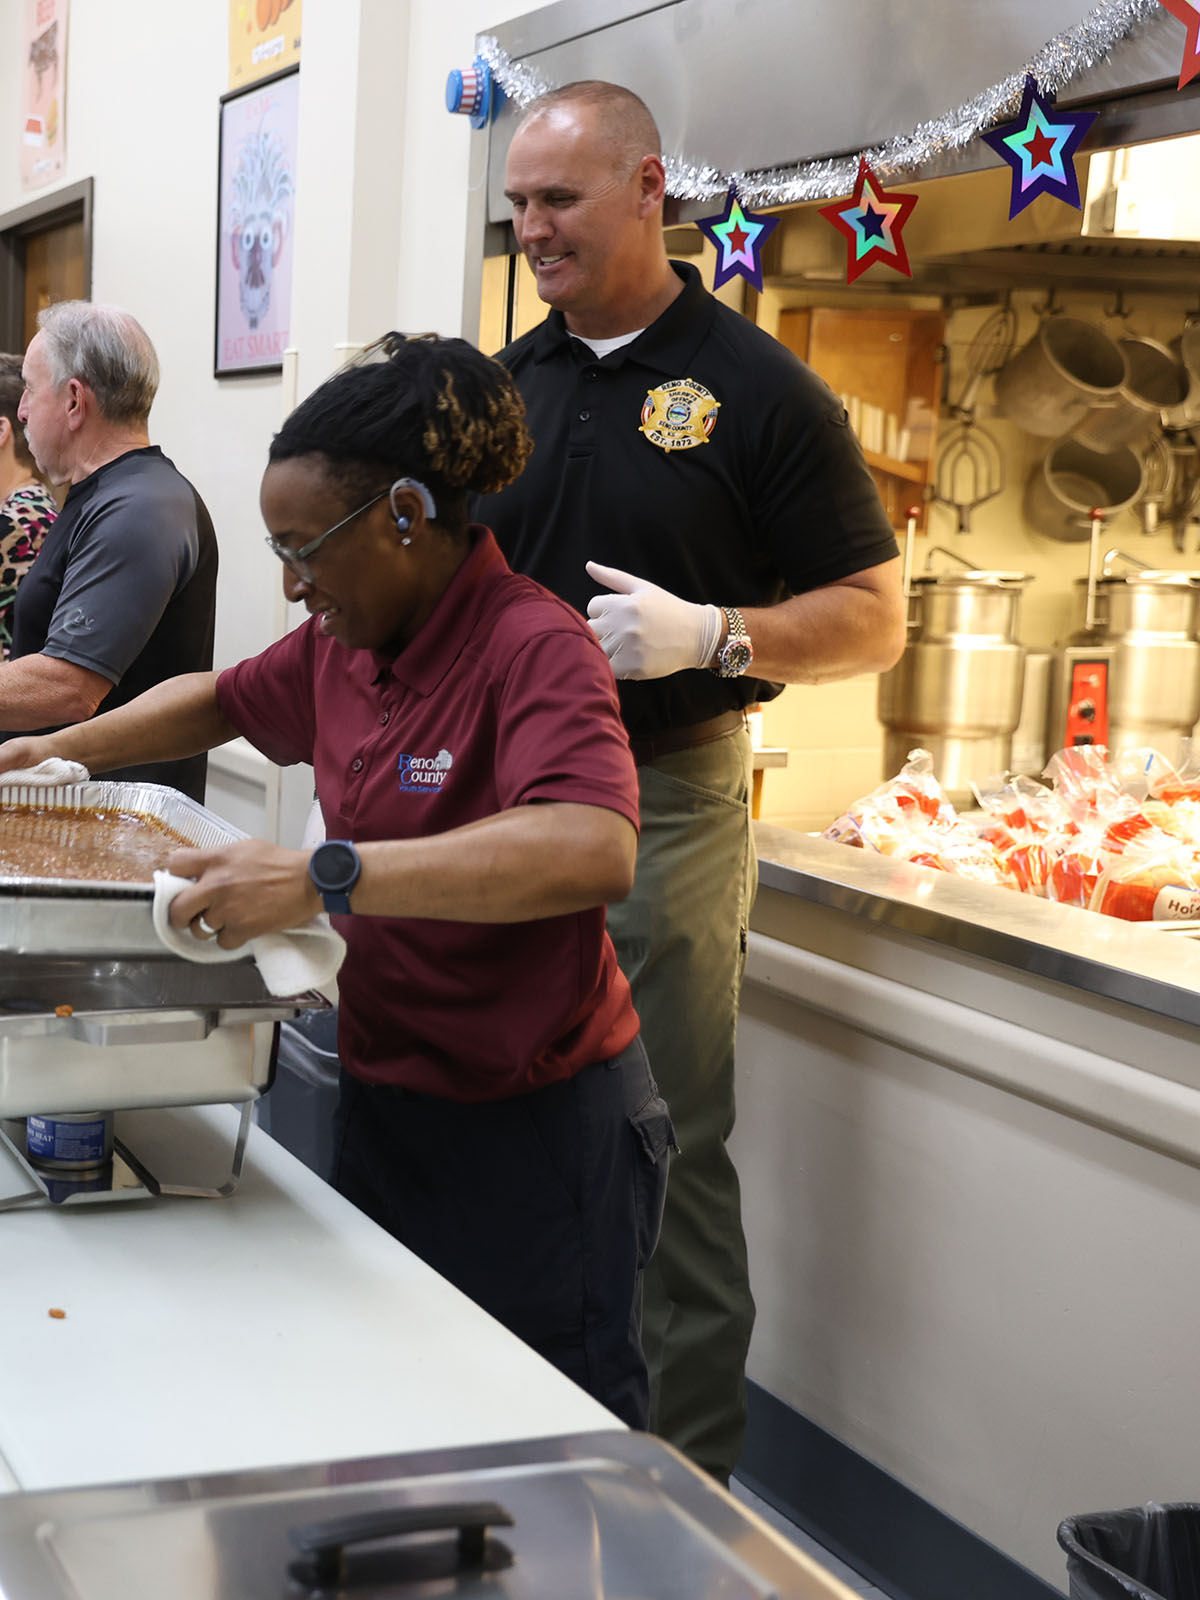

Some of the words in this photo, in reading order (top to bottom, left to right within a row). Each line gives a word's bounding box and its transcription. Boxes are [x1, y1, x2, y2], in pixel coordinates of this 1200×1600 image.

[661, 381, 681, 390] RENO
[684, 381, 710, 397] COUNTY
[670, 397, 693, 405] OFFICE
[671, 438, 693, 447] 1872
[397, 753, 435, 770] Reno
[400, 768, 448, 786] County
